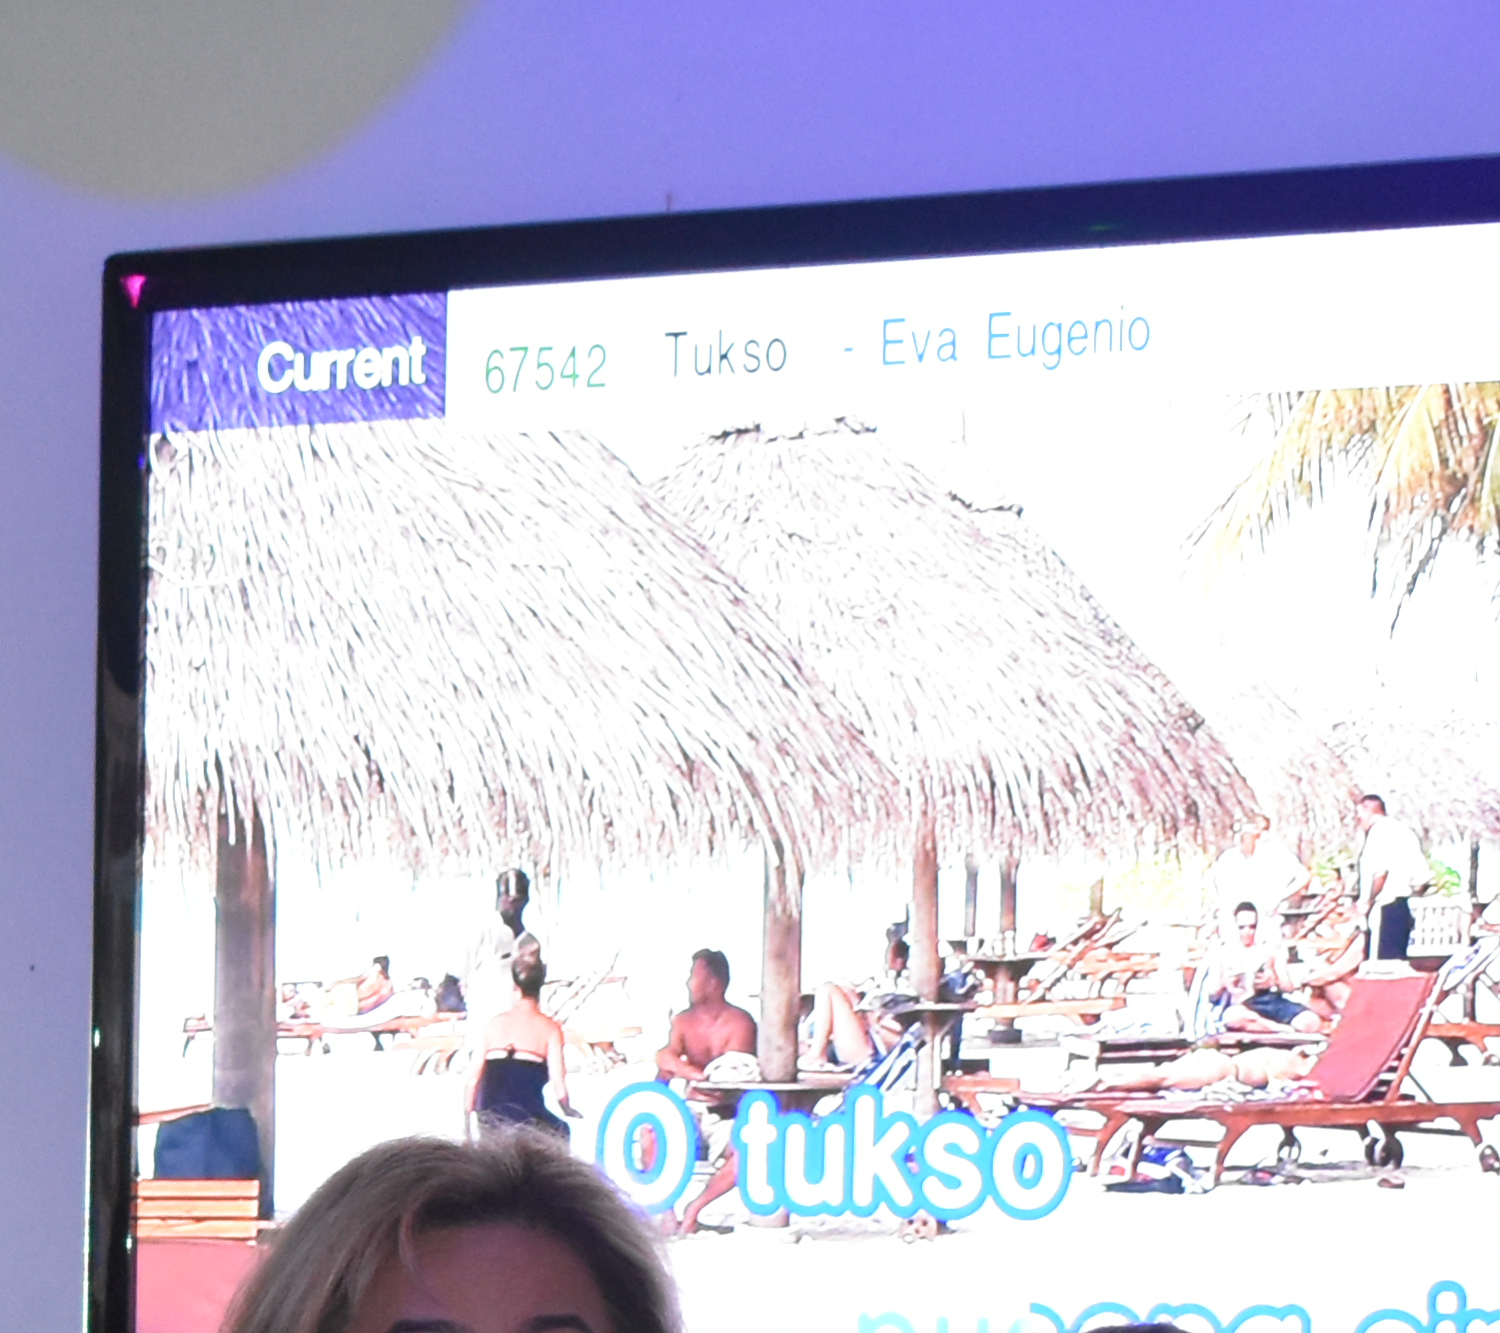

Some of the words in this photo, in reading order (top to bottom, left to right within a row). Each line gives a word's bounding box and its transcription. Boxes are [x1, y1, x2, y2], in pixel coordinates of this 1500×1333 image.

[256, 336, 427, 394] Current
[485, 343, 607, 395] 67542
[664, 329, 788, 378] Tukso
[881, 317, 958, 366] Eva
[987, 304, 1151, 371] Eugenio
[733, 1085, 1073, 1221] tukso
